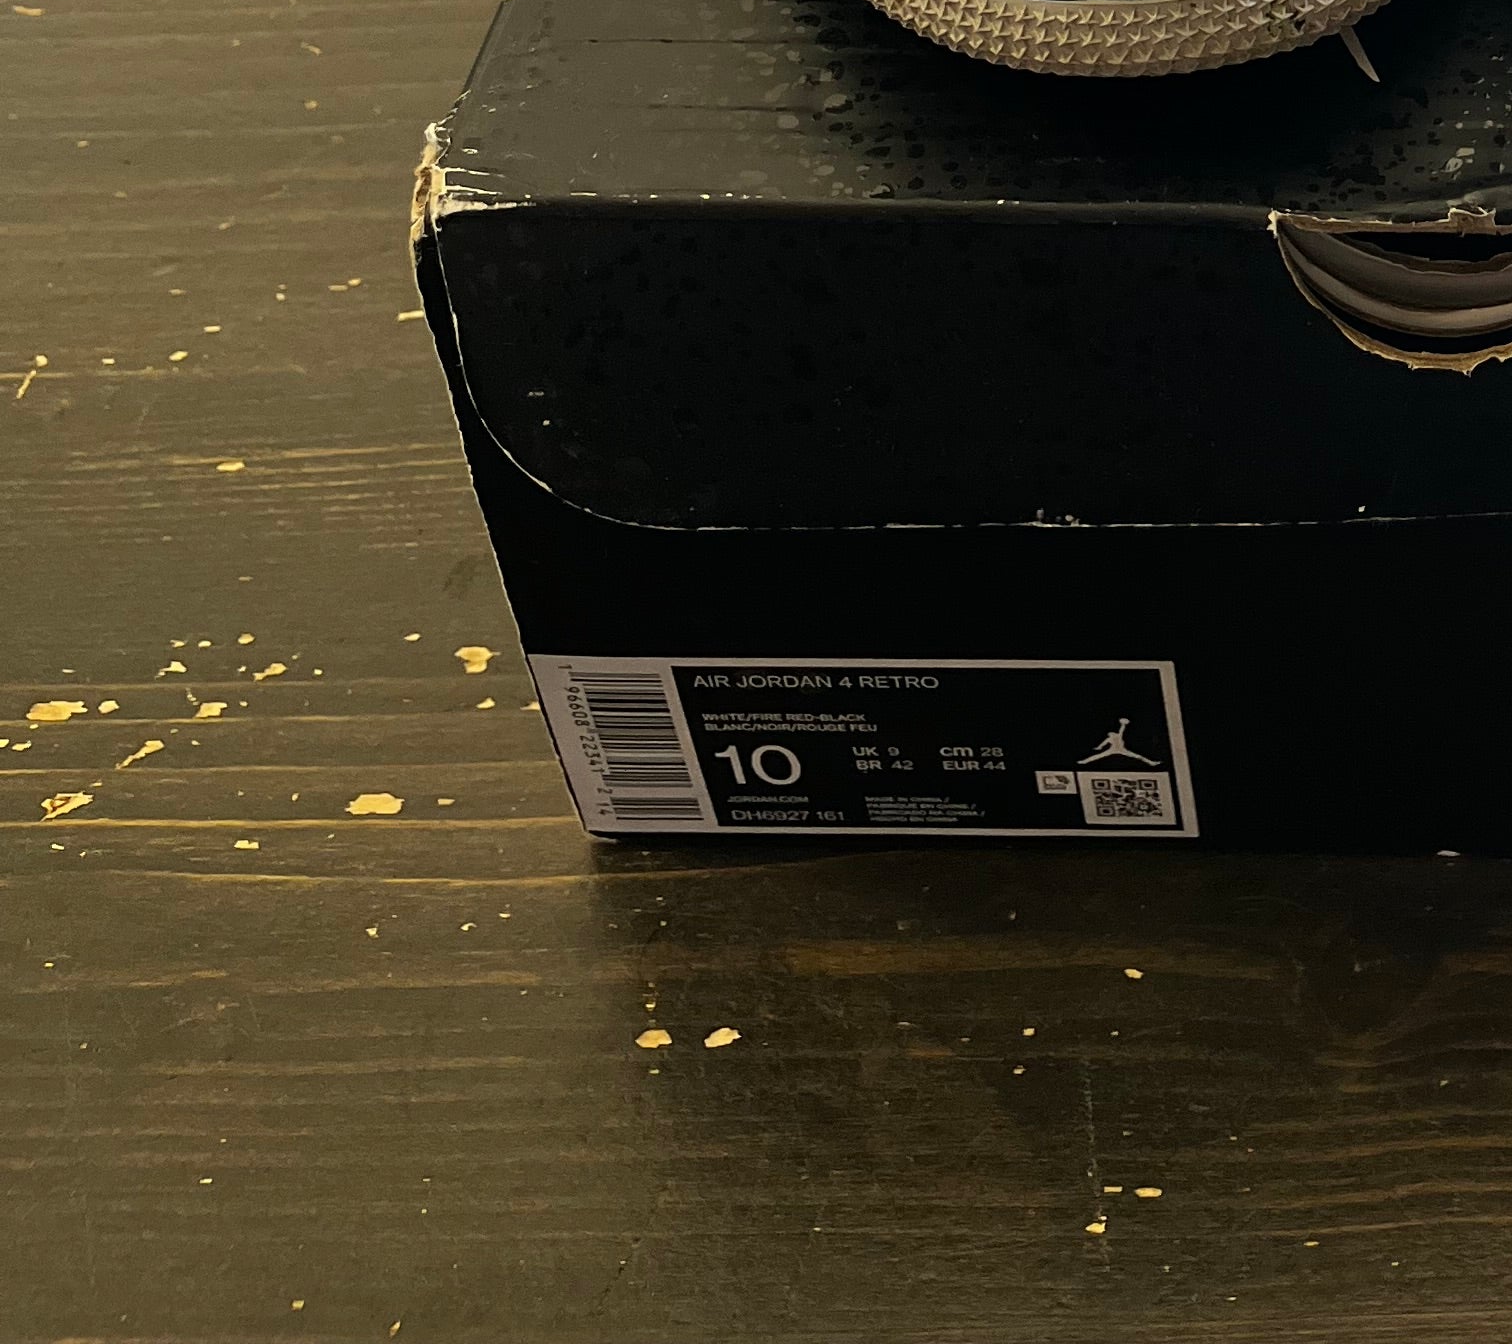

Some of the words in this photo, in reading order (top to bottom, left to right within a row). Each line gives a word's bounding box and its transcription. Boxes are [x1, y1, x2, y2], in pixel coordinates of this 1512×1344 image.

[693, 675, 732, 688] AIR
[736, 675, 833, 689] JORDAN
[838, 676, 853, 688] 4
[858, 676, 940, 689] RETRO
[565, 686, 590, 727] 96608
[702, 713, 784, 722] WHITE/FIRE
[785, 713, 867, 722] RED-BLACK
[852, 746, 880, 757] UK
[887, 746, 900, 757] 9
[939, 746, 974, 757] cm
[980, 747, 1004, 757] 28
[714, 744, 802, 786] 10
[856, 759, 883, 771] BR
[891, 760, 915, 771] 42
[942, 760, 981, 771] EUR
[983, 761, 1007, 771] 44
[731, 810, 811, 821] DH6927
[816, 810, 845, 821] 161
